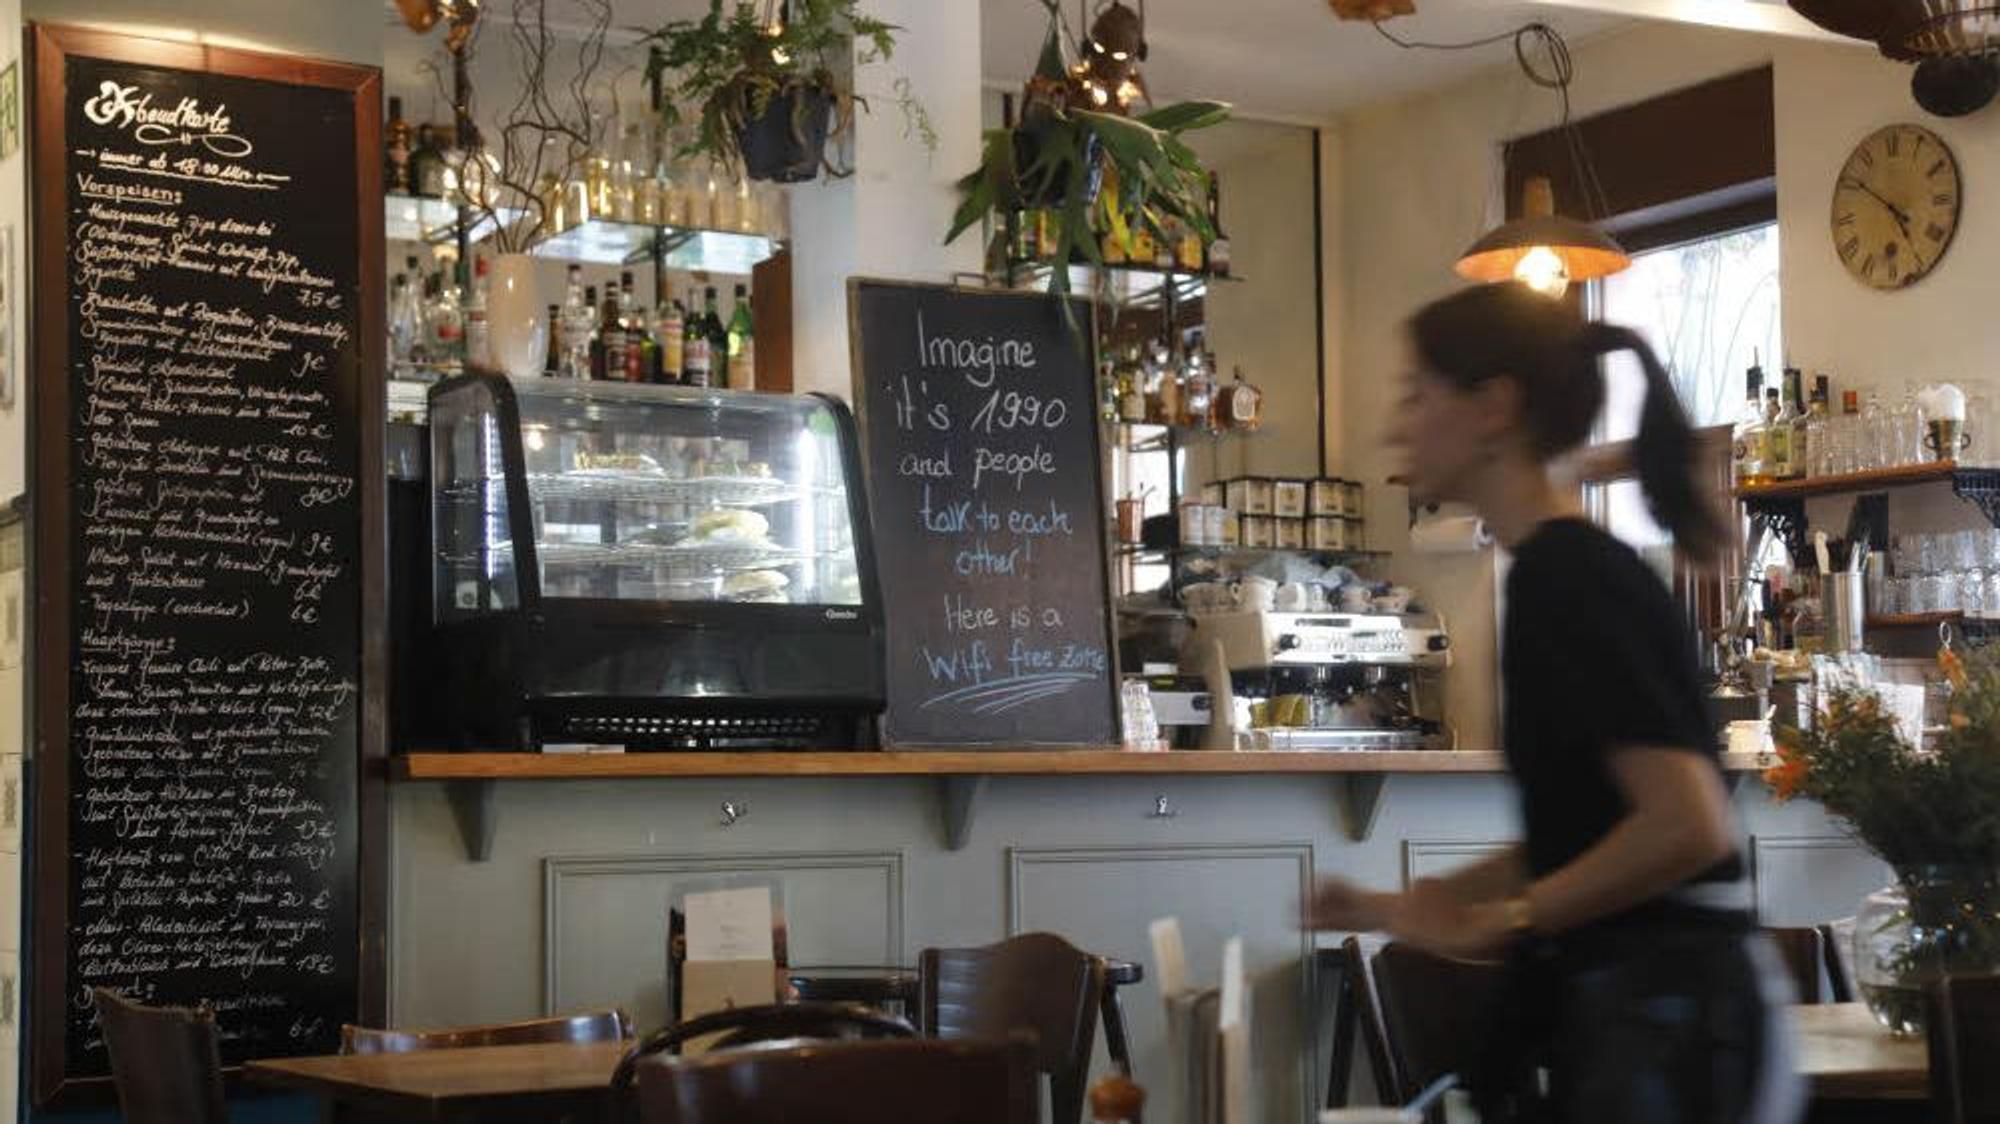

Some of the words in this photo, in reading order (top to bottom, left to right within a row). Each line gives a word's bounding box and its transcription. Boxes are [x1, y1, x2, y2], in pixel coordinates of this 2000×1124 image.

[918, 309, 1037, 388] Imagine
[969, 388, 1067, 434] 1990
[900, 448, 953, 477] and
[973, 443, 1057, 492] people
[919, 482, 973, 532] talk
[977, 501, 1001, 532] to
[1008, 498, 1073, 535] each
[944, 592, 1000, 633] Here
[1010, 604, 1032, 629] is
[1042, 606, 1064, 628] a
[1008, 637, 1054, 679] free
